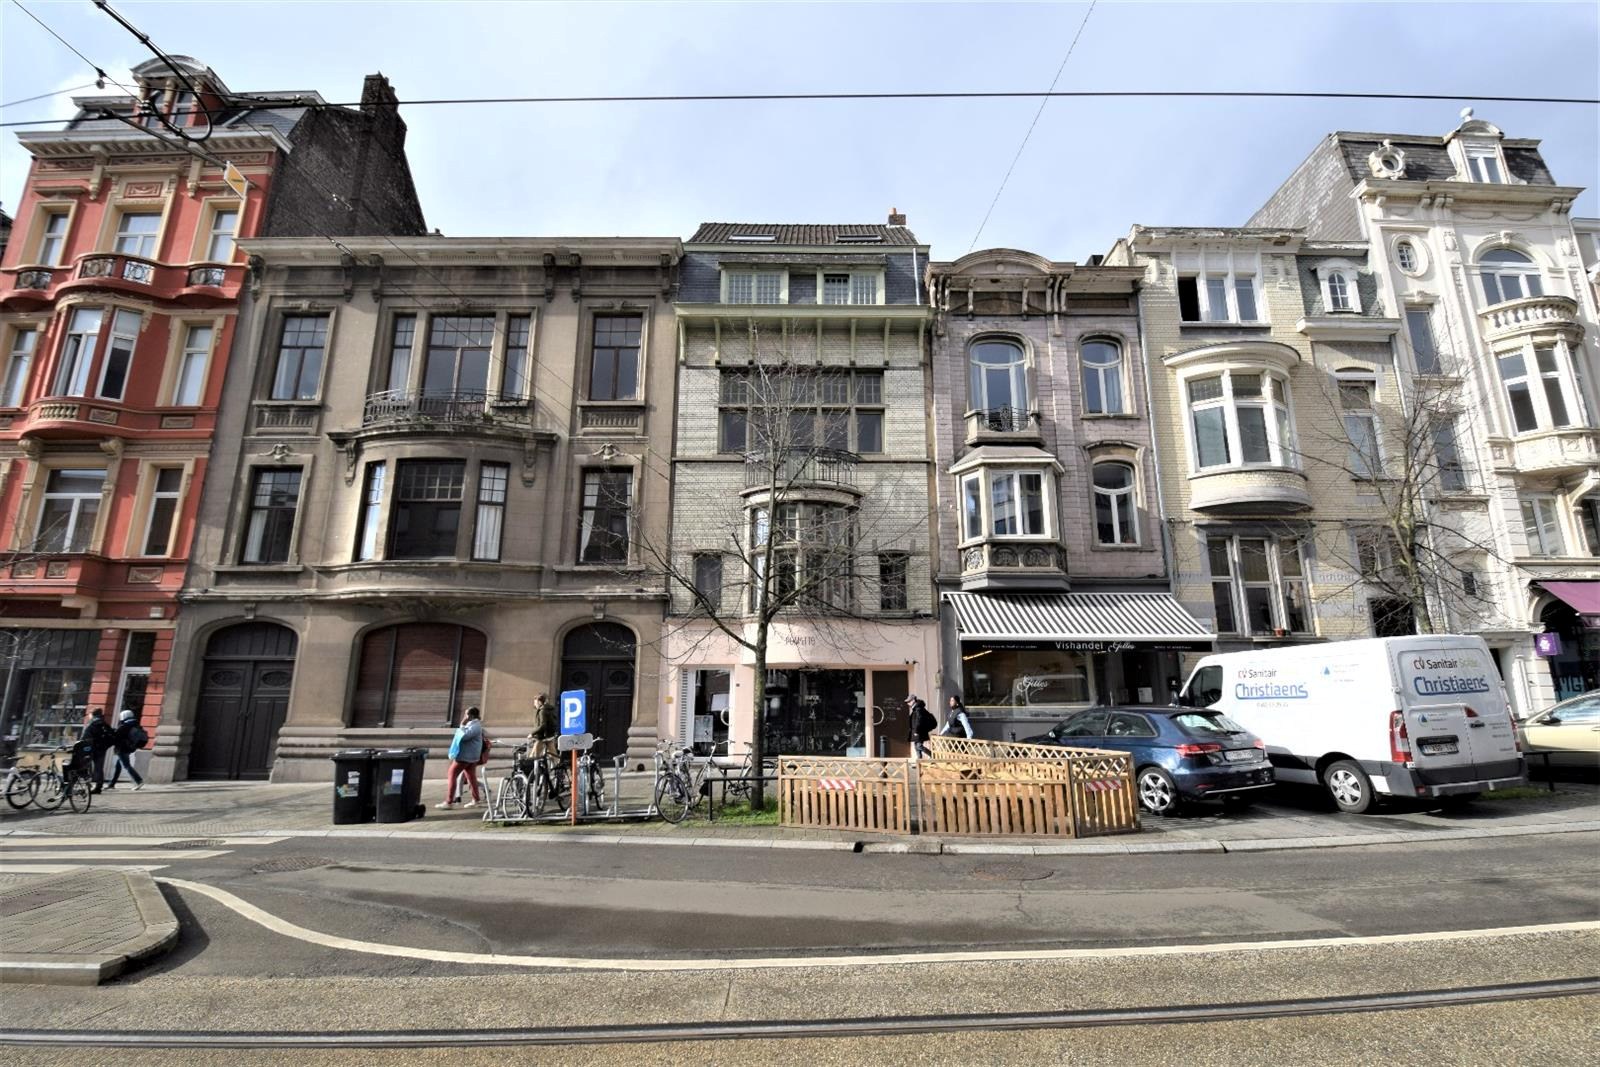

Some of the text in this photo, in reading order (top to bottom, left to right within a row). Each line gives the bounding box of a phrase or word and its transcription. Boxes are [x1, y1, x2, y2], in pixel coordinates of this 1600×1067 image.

[1055, 641, 1104, 650] Vishandel
[1426, 659, 1458, 669] Sanitair
[1248, 668, 1277, 678] Sanitair
[1235, 682, 1308, 700] Christiaens
[1414, 675, 1489, 696] Christiaens
[564, 697, 582, 729] P
